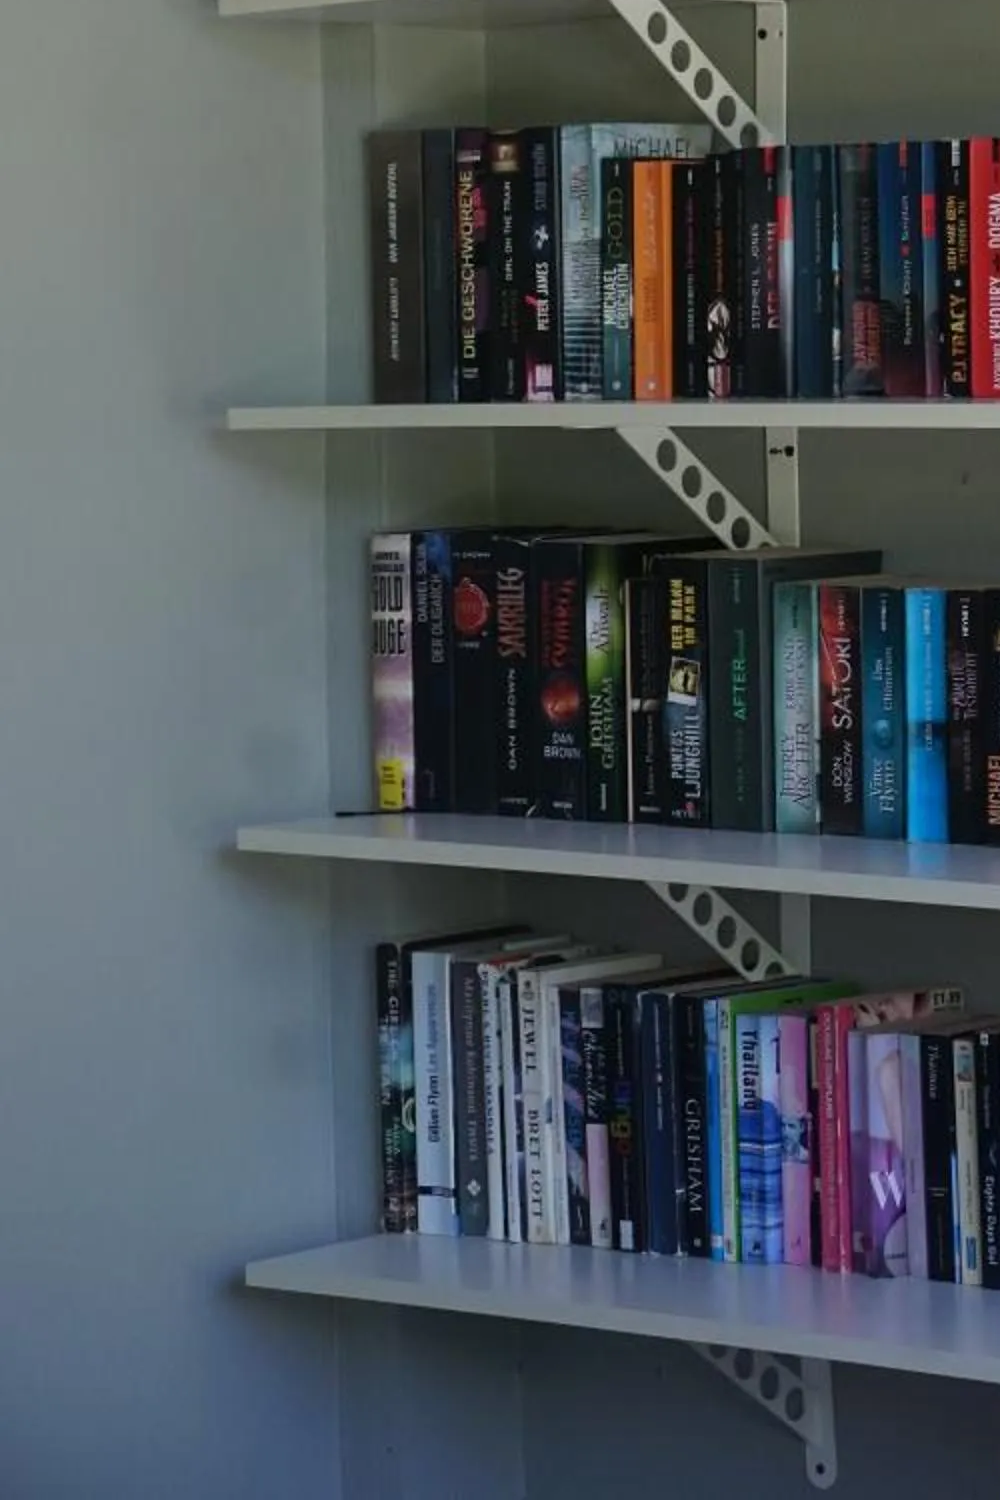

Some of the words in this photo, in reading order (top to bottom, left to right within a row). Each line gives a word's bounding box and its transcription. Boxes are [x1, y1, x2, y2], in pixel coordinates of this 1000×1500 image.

[459, 170, 476, 321] GESCHWORENE
[607, 186, 624, 259] GOLD
[535, 262, 549, 296] JAMES
[603, 268, 616, 325] MICHAEL
[615, 263, 629, 329] CRICHTON
[535, 300, 550, 331] PETER
[949, 294, 966, 357] TRACY
[463, 327, 476, 359] DIE
[417, 580, 428, 623] DANIEL
[497, 567, 527, 658] SAKRILEG
[594, 587, 610, 655] Anwalt
[670, 579, 684, 621] MANN
[685, 585, 697, 622] PARK
[432, 639, 445, 663] DER
[672, 625, 684, 650] DER
[506, 668, 518, 729] BROWN
[732, 659, 748, 721] AFTER
[831, 637, 853, 730] SATORI
[551, 732, 575, 745] DAN
[589, 695, 603, 748] JOHN
[601, 678, 615, 770] GRISHAM
[507, 735, 519, 770] DAN
[543, 746, 582, 760] BROWN
[671, 730, 683, 779] PONTUS
[683, 713, 701, 799] LJUNGHILL
[779, 733, 795, 797] JEFFREY
[792, 722, 811, 810] ARCHER
[832, 756, 842, 787] DON
[843, 739, 854, 803] WINSLOW
[865, 762, 883, 799] Vince
[880, 759, 898, 813] Flynn
[522, 1006, 539, 1077] JEWEL
[427, 1076, 440, 1104] Flynn
[741, 1030, 760, 1111] Thailand
[428, 1105, 441, 1143] Gillian
[527, 1109, 541, 1160] BRET
[685, 1098, 704, 1213] GRISHAM
[531, 1167, 544, 1220] LOTT
